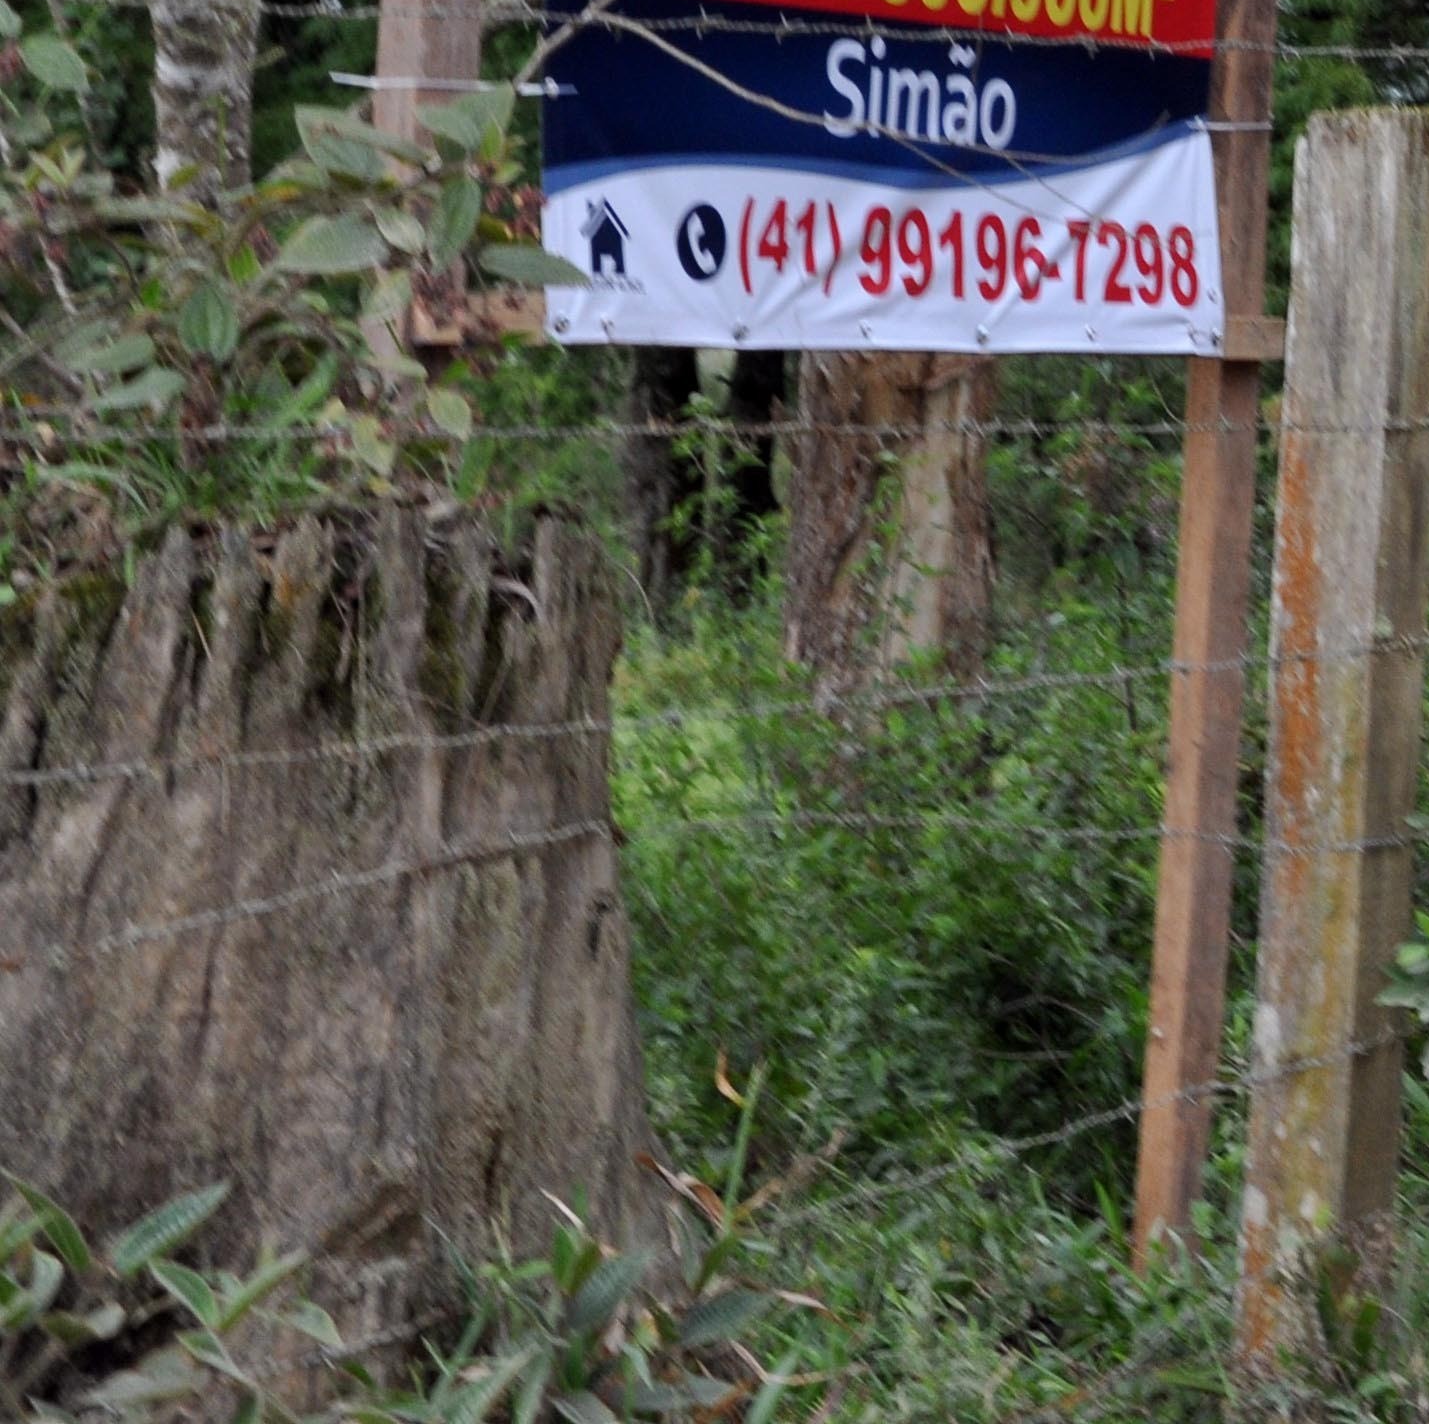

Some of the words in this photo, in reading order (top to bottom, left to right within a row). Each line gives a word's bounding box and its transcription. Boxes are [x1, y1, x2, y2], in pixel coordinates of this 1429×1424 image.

[822, 38, 1017, 149] Simão
[737, 197, 842, 294] (41)
[860, 206, 1199, 306] 99196-7298
